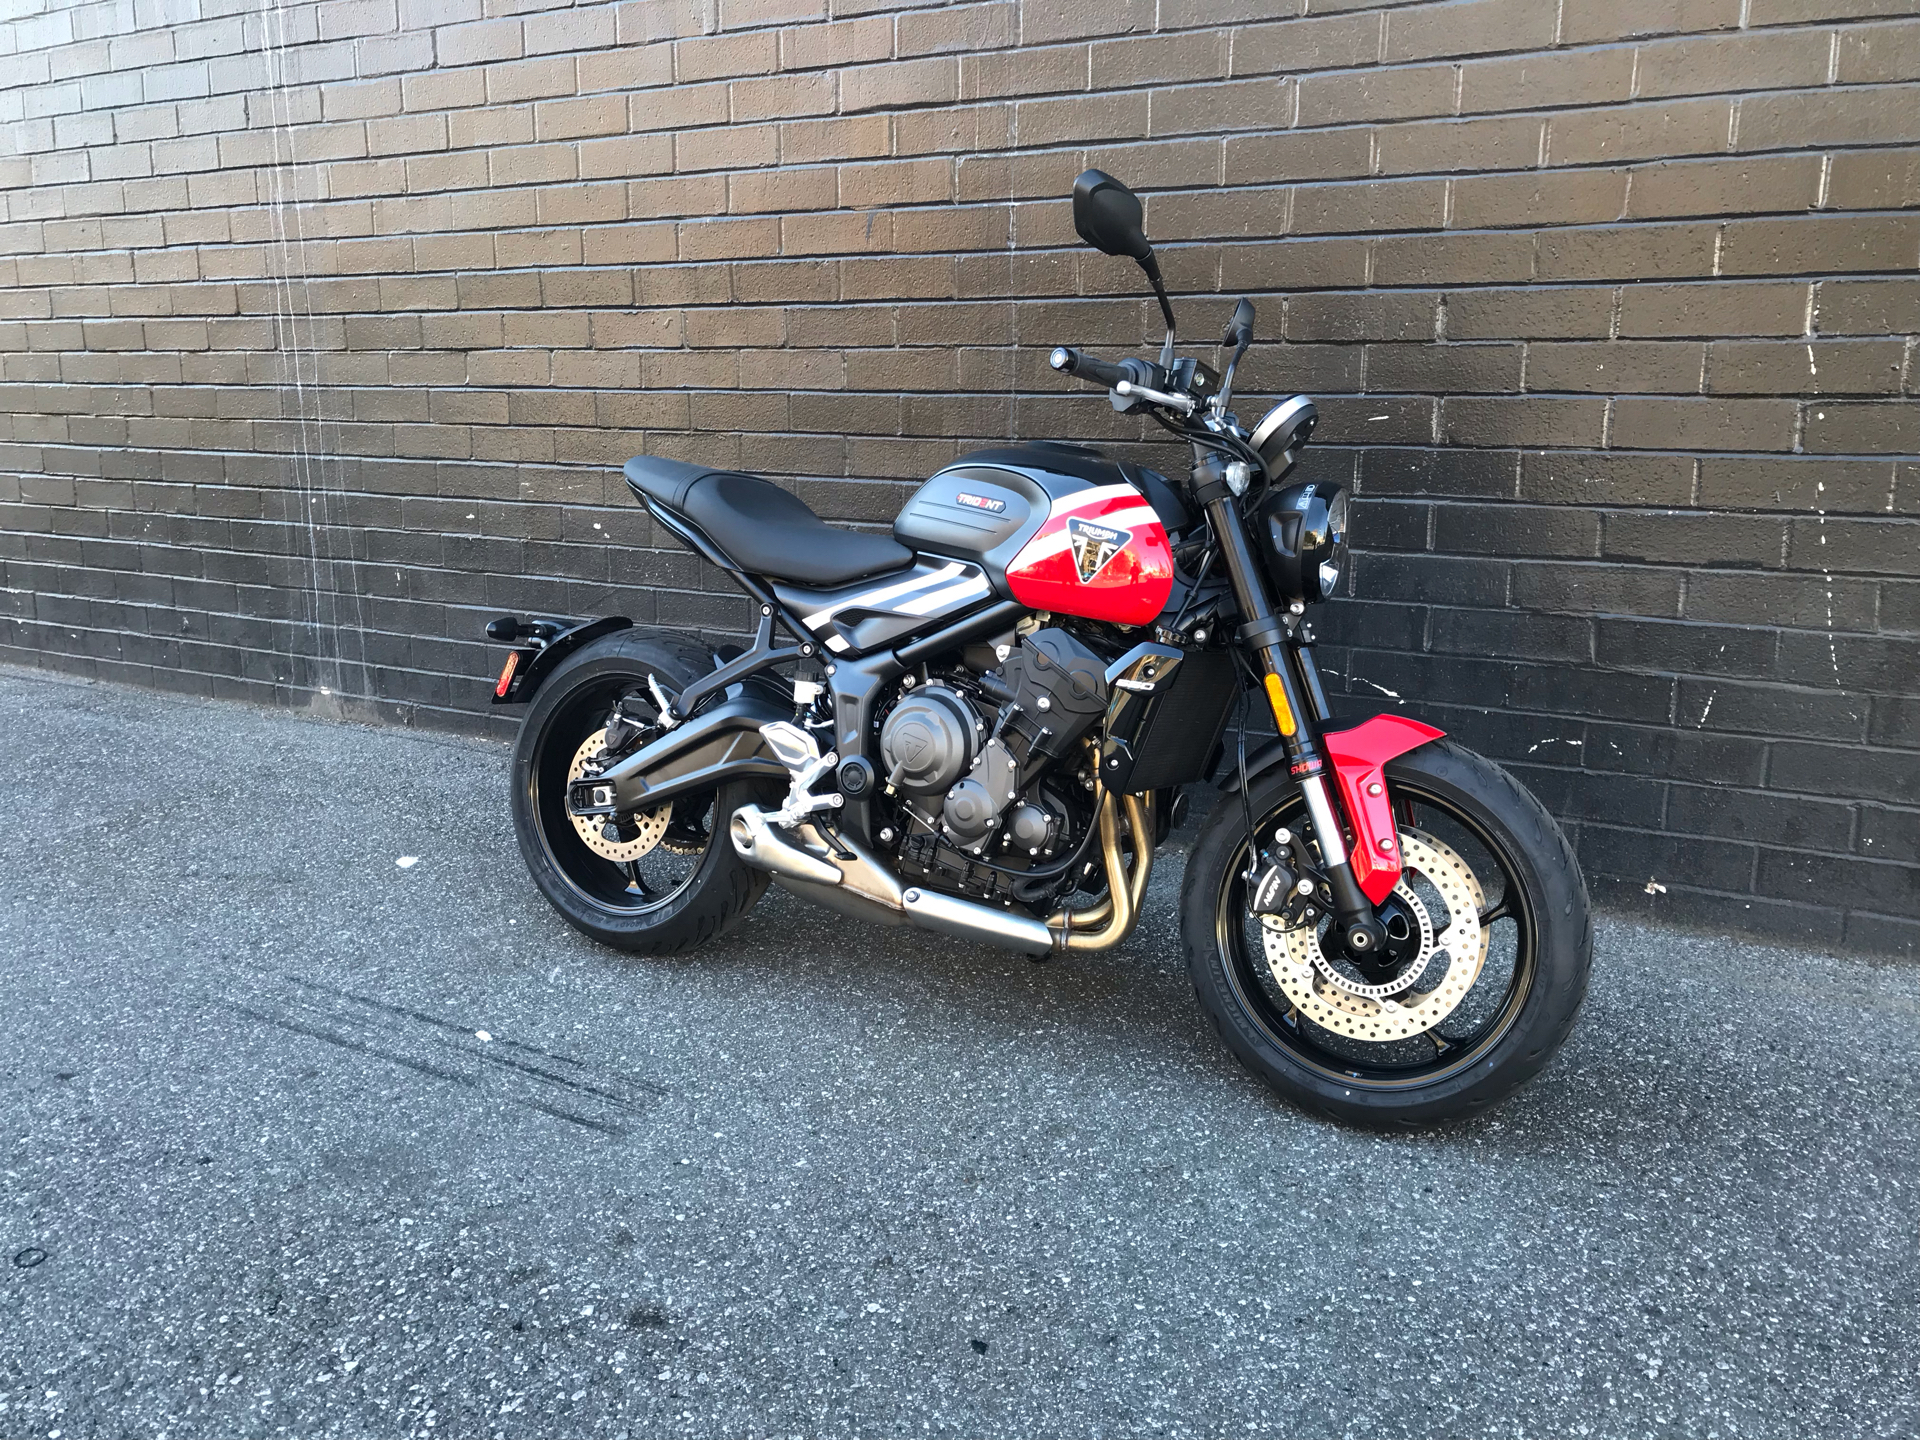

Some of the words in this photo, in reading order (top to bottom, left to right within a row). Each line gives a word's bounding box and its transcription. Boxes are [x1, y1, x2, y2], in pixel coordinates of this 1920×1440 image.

[958, 493, 1004, 510] TRIDENT
[1078, 523, 1118, 541] TRIUMPH
[1290, 759, 1322, 775] SHOWA
[1209, 959, 1249, 1031] MICHELIN
